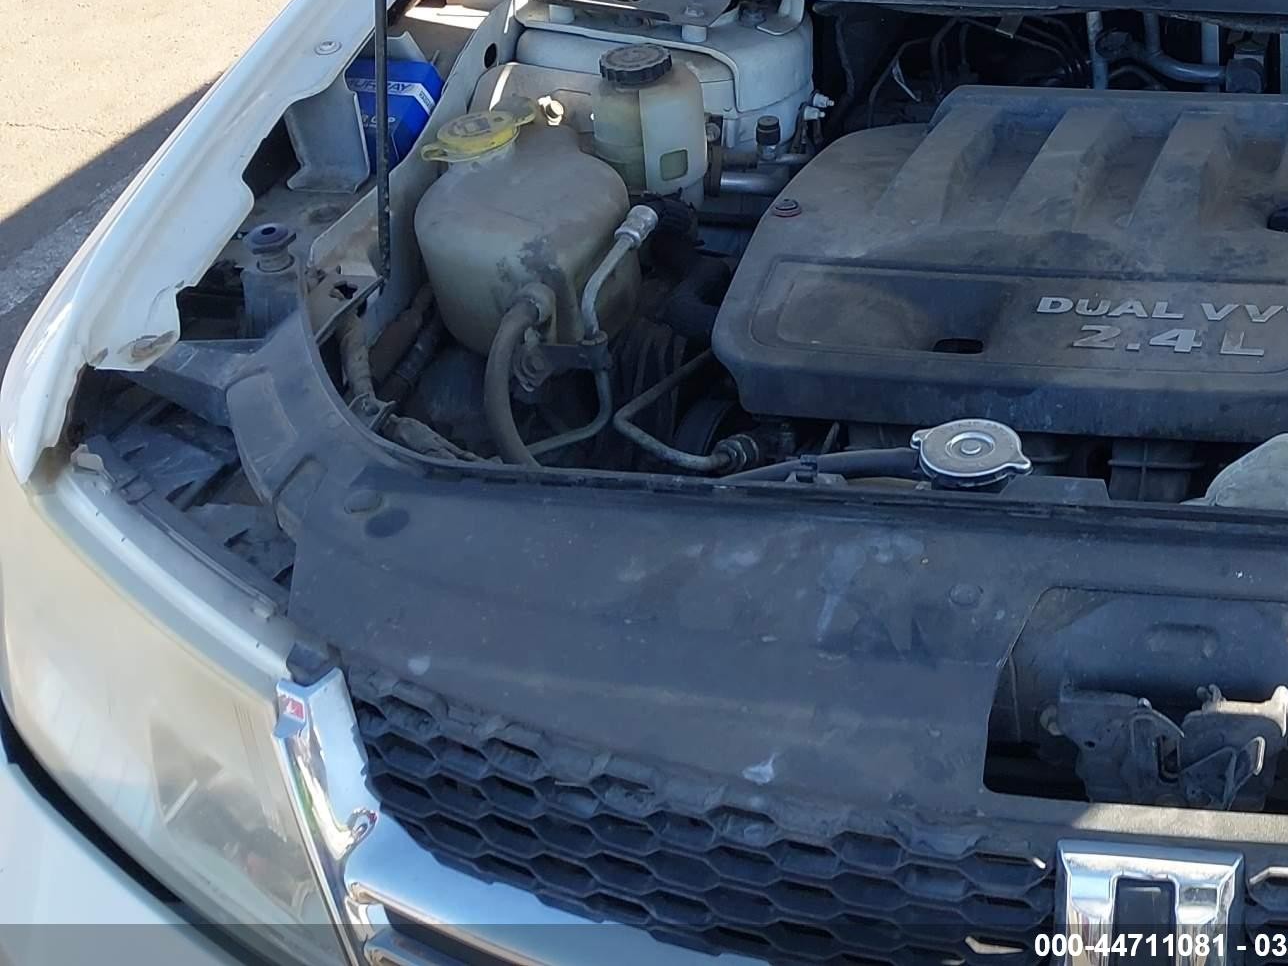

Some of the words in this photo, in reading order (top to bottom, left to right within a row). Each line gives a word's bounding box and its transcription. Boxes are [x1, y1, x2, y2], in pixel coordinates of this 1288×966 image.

[1036, 296, 1185, 320] DUAL
[1071, 325, 1202, 353] 2.4
[1220, 331, 1265, 356] L
